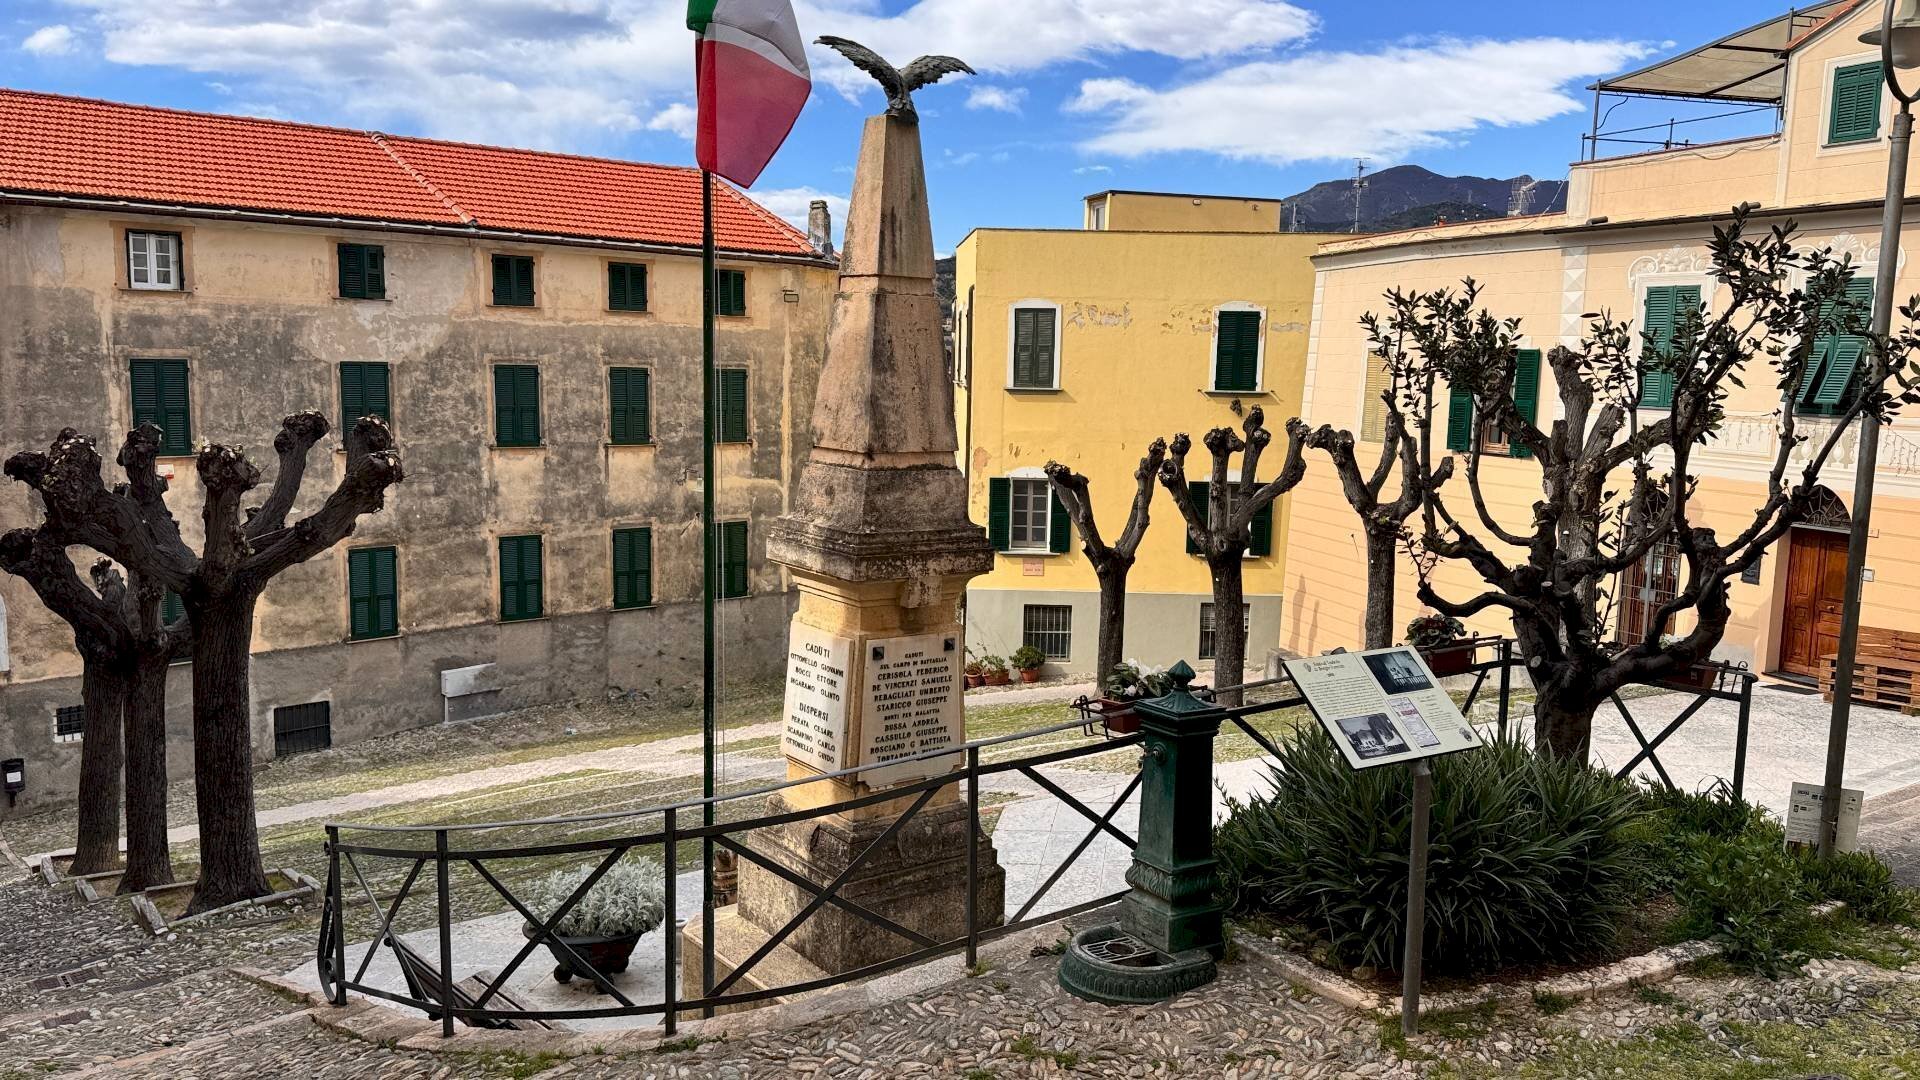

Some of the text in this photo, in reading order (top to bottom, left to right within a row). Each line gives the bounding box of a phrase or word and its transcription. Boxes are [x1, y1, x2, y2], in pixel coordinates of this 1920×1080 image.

[805, 643, 830, 658] CADUTI
[920, 657, 948, 665] BATTAGLIA
[878, 666, 948, 680] CERISOLA FEDERICO
[816, 674, 837, 688] ETTORE
[885, 680, 917, 690] VINCENZI
[921, 675, 952, 686] SAMUELE
[820, 688, 840, 702] OLINTO
[874, 686, 950, 702] REBAGLIATI UMBERTO
[876, 696, 948, 712] STARICCO GIUSEPPE
[800, 702, 828, 722] DISPERSI
[912, 718, 939, 727] ANDREA
[916, 726, 948, 736] GIUSEPPE
[818, 740, 836, 752] CARLO
[920, 736, 951, 746] BATTISTA
